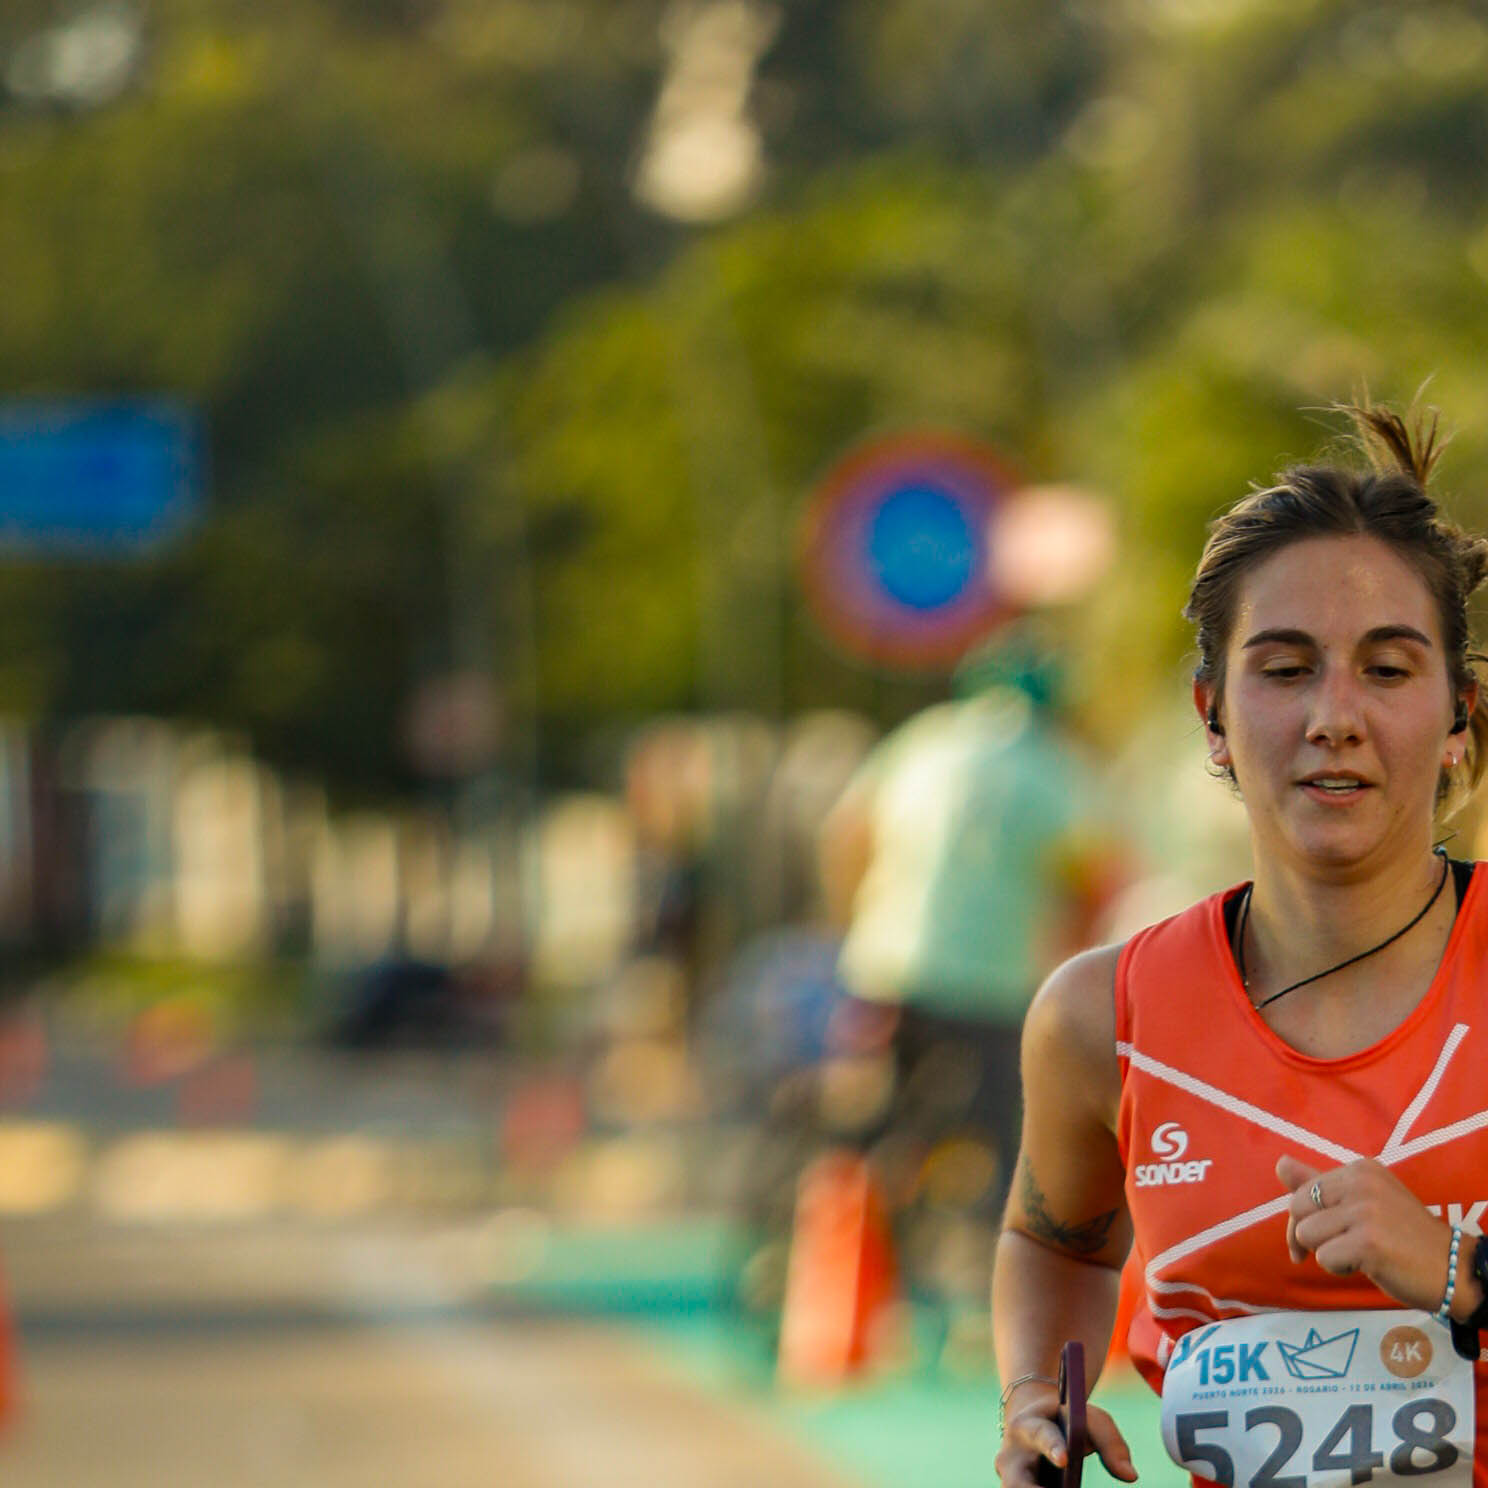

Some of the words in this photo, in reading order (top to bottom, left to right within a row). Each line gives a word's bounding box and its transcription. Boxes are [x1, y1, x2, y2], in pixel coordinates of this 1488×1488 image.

[1391, 1340, 1422, 1362] 4K
[1195, 1341, 1271, 1386] 15K
[1363, 1383, 1376, 1392] DE
